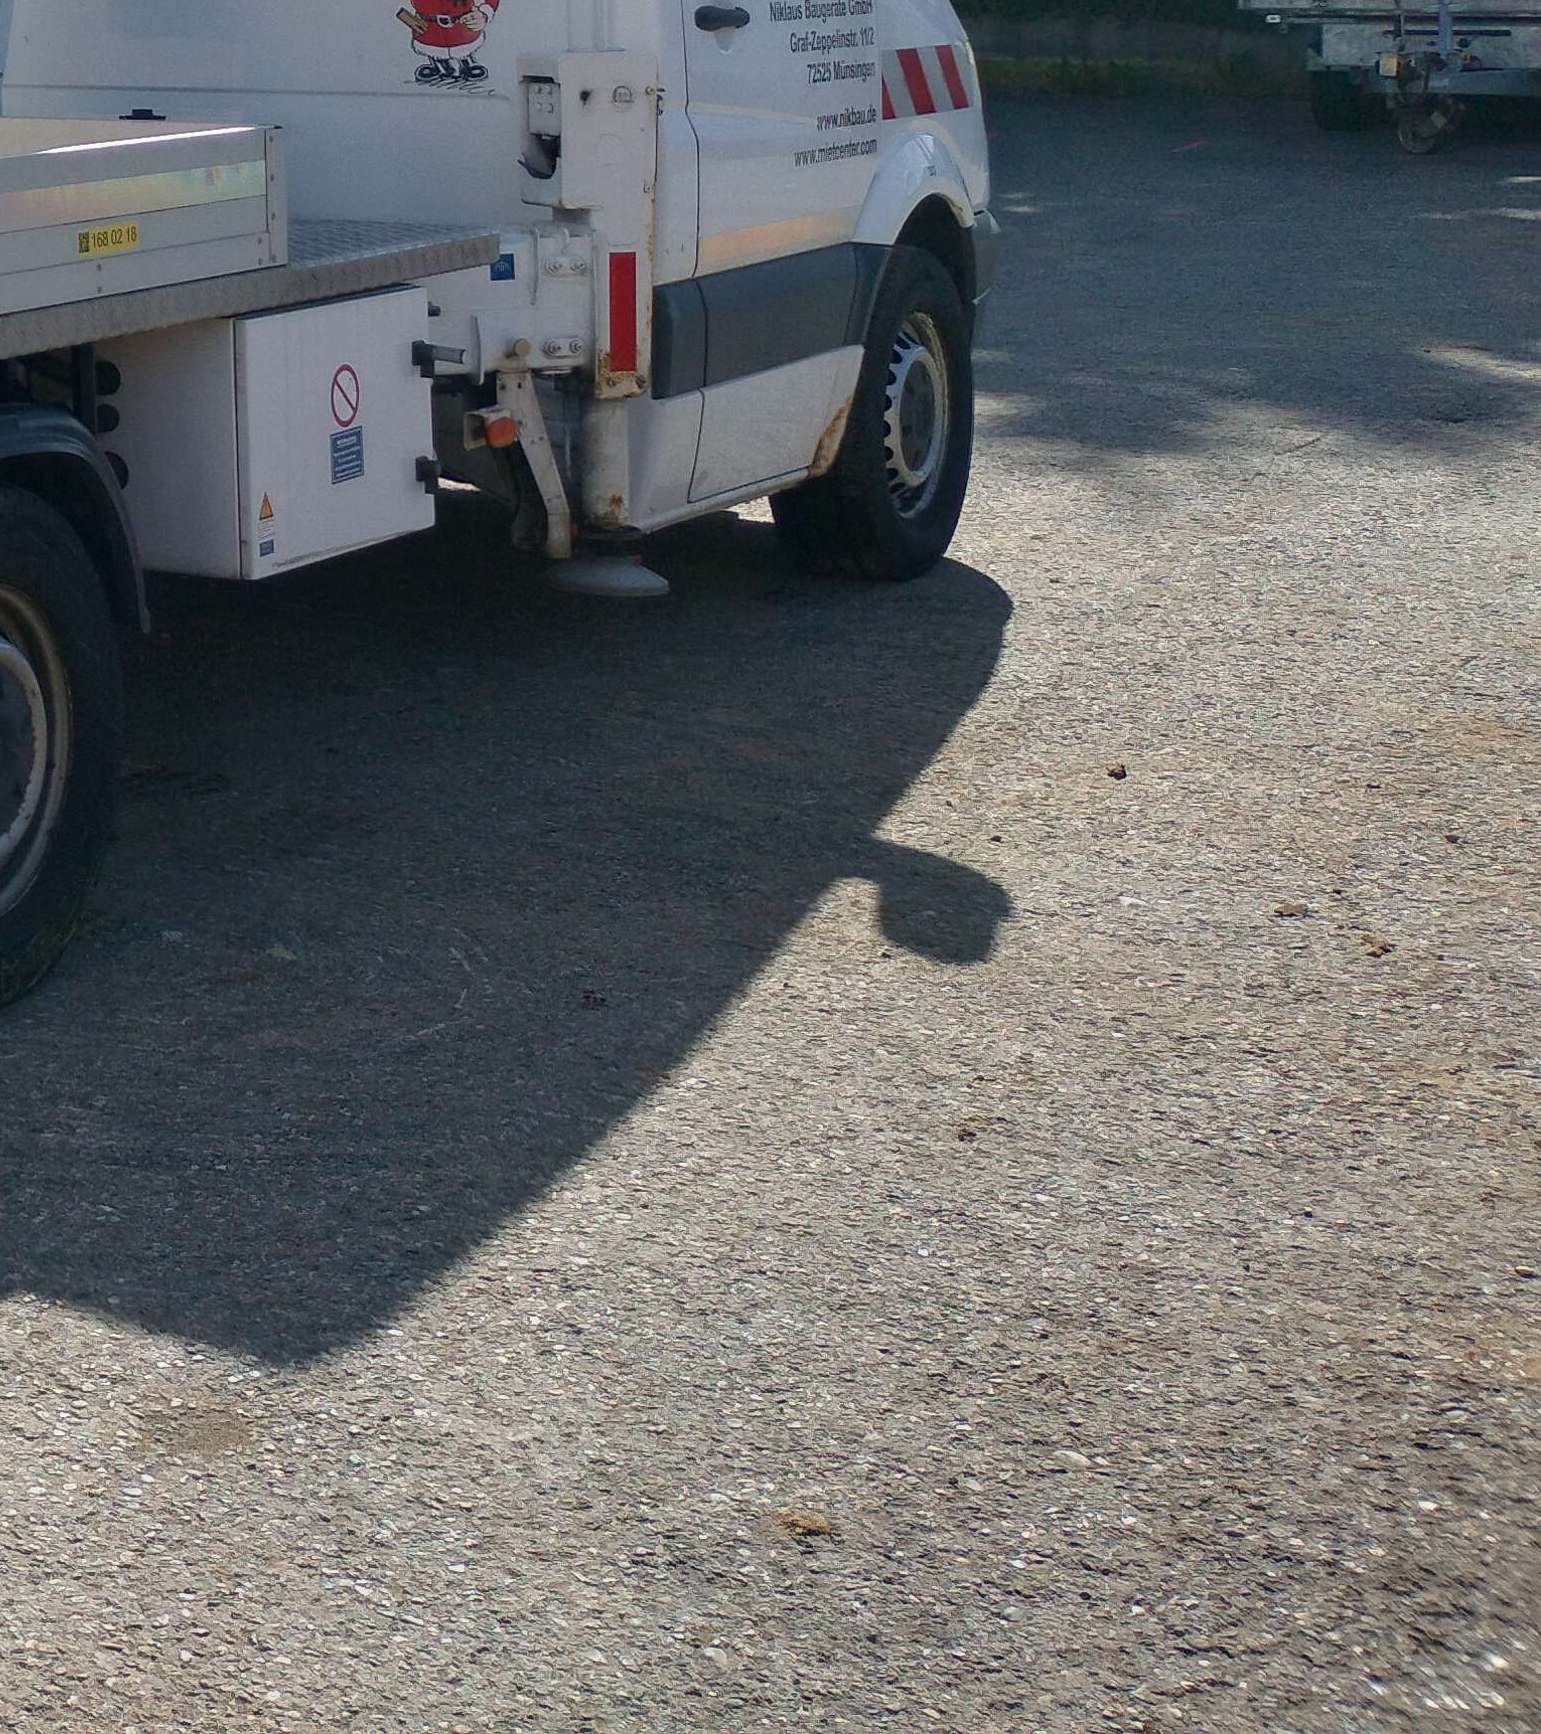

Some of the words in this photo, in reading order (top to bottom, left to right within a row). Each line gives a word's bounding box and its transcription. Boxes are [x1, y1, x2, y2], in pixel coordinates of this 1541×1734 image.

[769, 1, 803, 22] Niklaus
[790, 28, 858, 55] Graf-Zeppelinstr.
[807, 61, 832, 84] 72525
[833, 58, 876, 83] Münsingen
[816, 104, 877, 131] www.nikbau.de
[794, 138, 878, 168] www.mietcenter.com
[92, 231, 109, 248] 168
[111, 228, 123, 245] 02
[126, 226, 137, 243] 18
